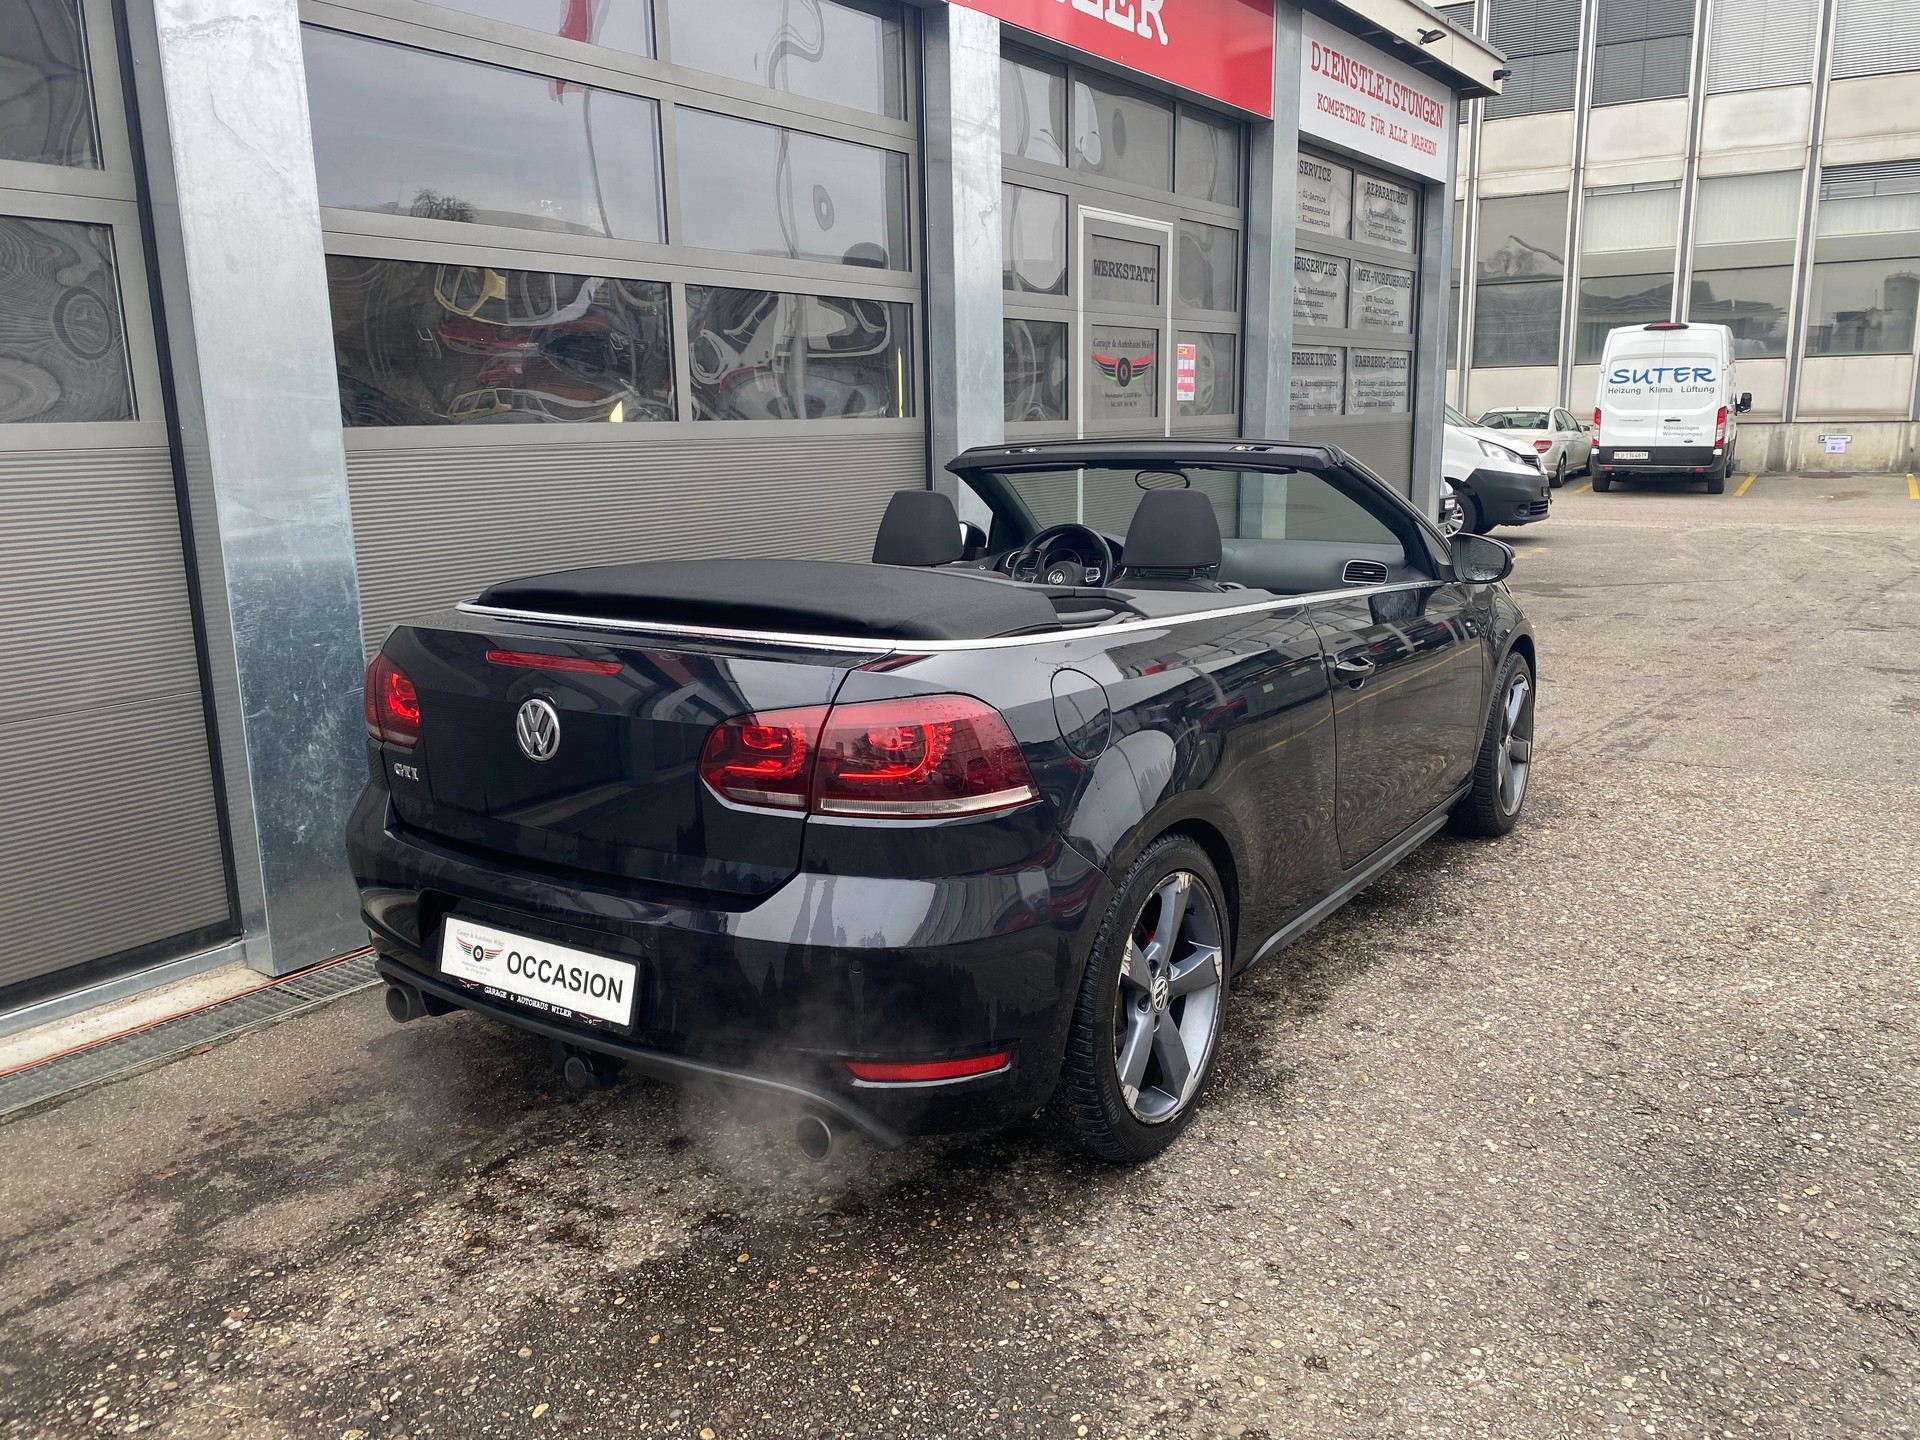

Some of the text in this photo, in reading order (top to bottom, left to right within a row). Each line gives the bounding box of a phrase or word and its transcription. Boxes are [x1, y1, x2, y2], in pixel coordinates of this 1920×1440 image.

[1311, 41, 1444, 128] DIENSTLEISTUNGEN
[1317, 93, 1437, 156] KOMPETENZ FÜR ALLE MARKEN
[1299, 160, 1332, 182] SERVICE
[1366, 182, 1409, 206] REPARATUREN
[1092, 259, 1156, 283] WERKSTATT
[1609, 367, 1716, 385] SUTER
[1608, 385, 1715, 396] Heizung Klima Lüftung
[393, 762, 420, 782] GTI
[507, 951, 623, 1004] OCCASION
[484, 986, 572, 1019] GARAGE & AUTOHAUS WILER
